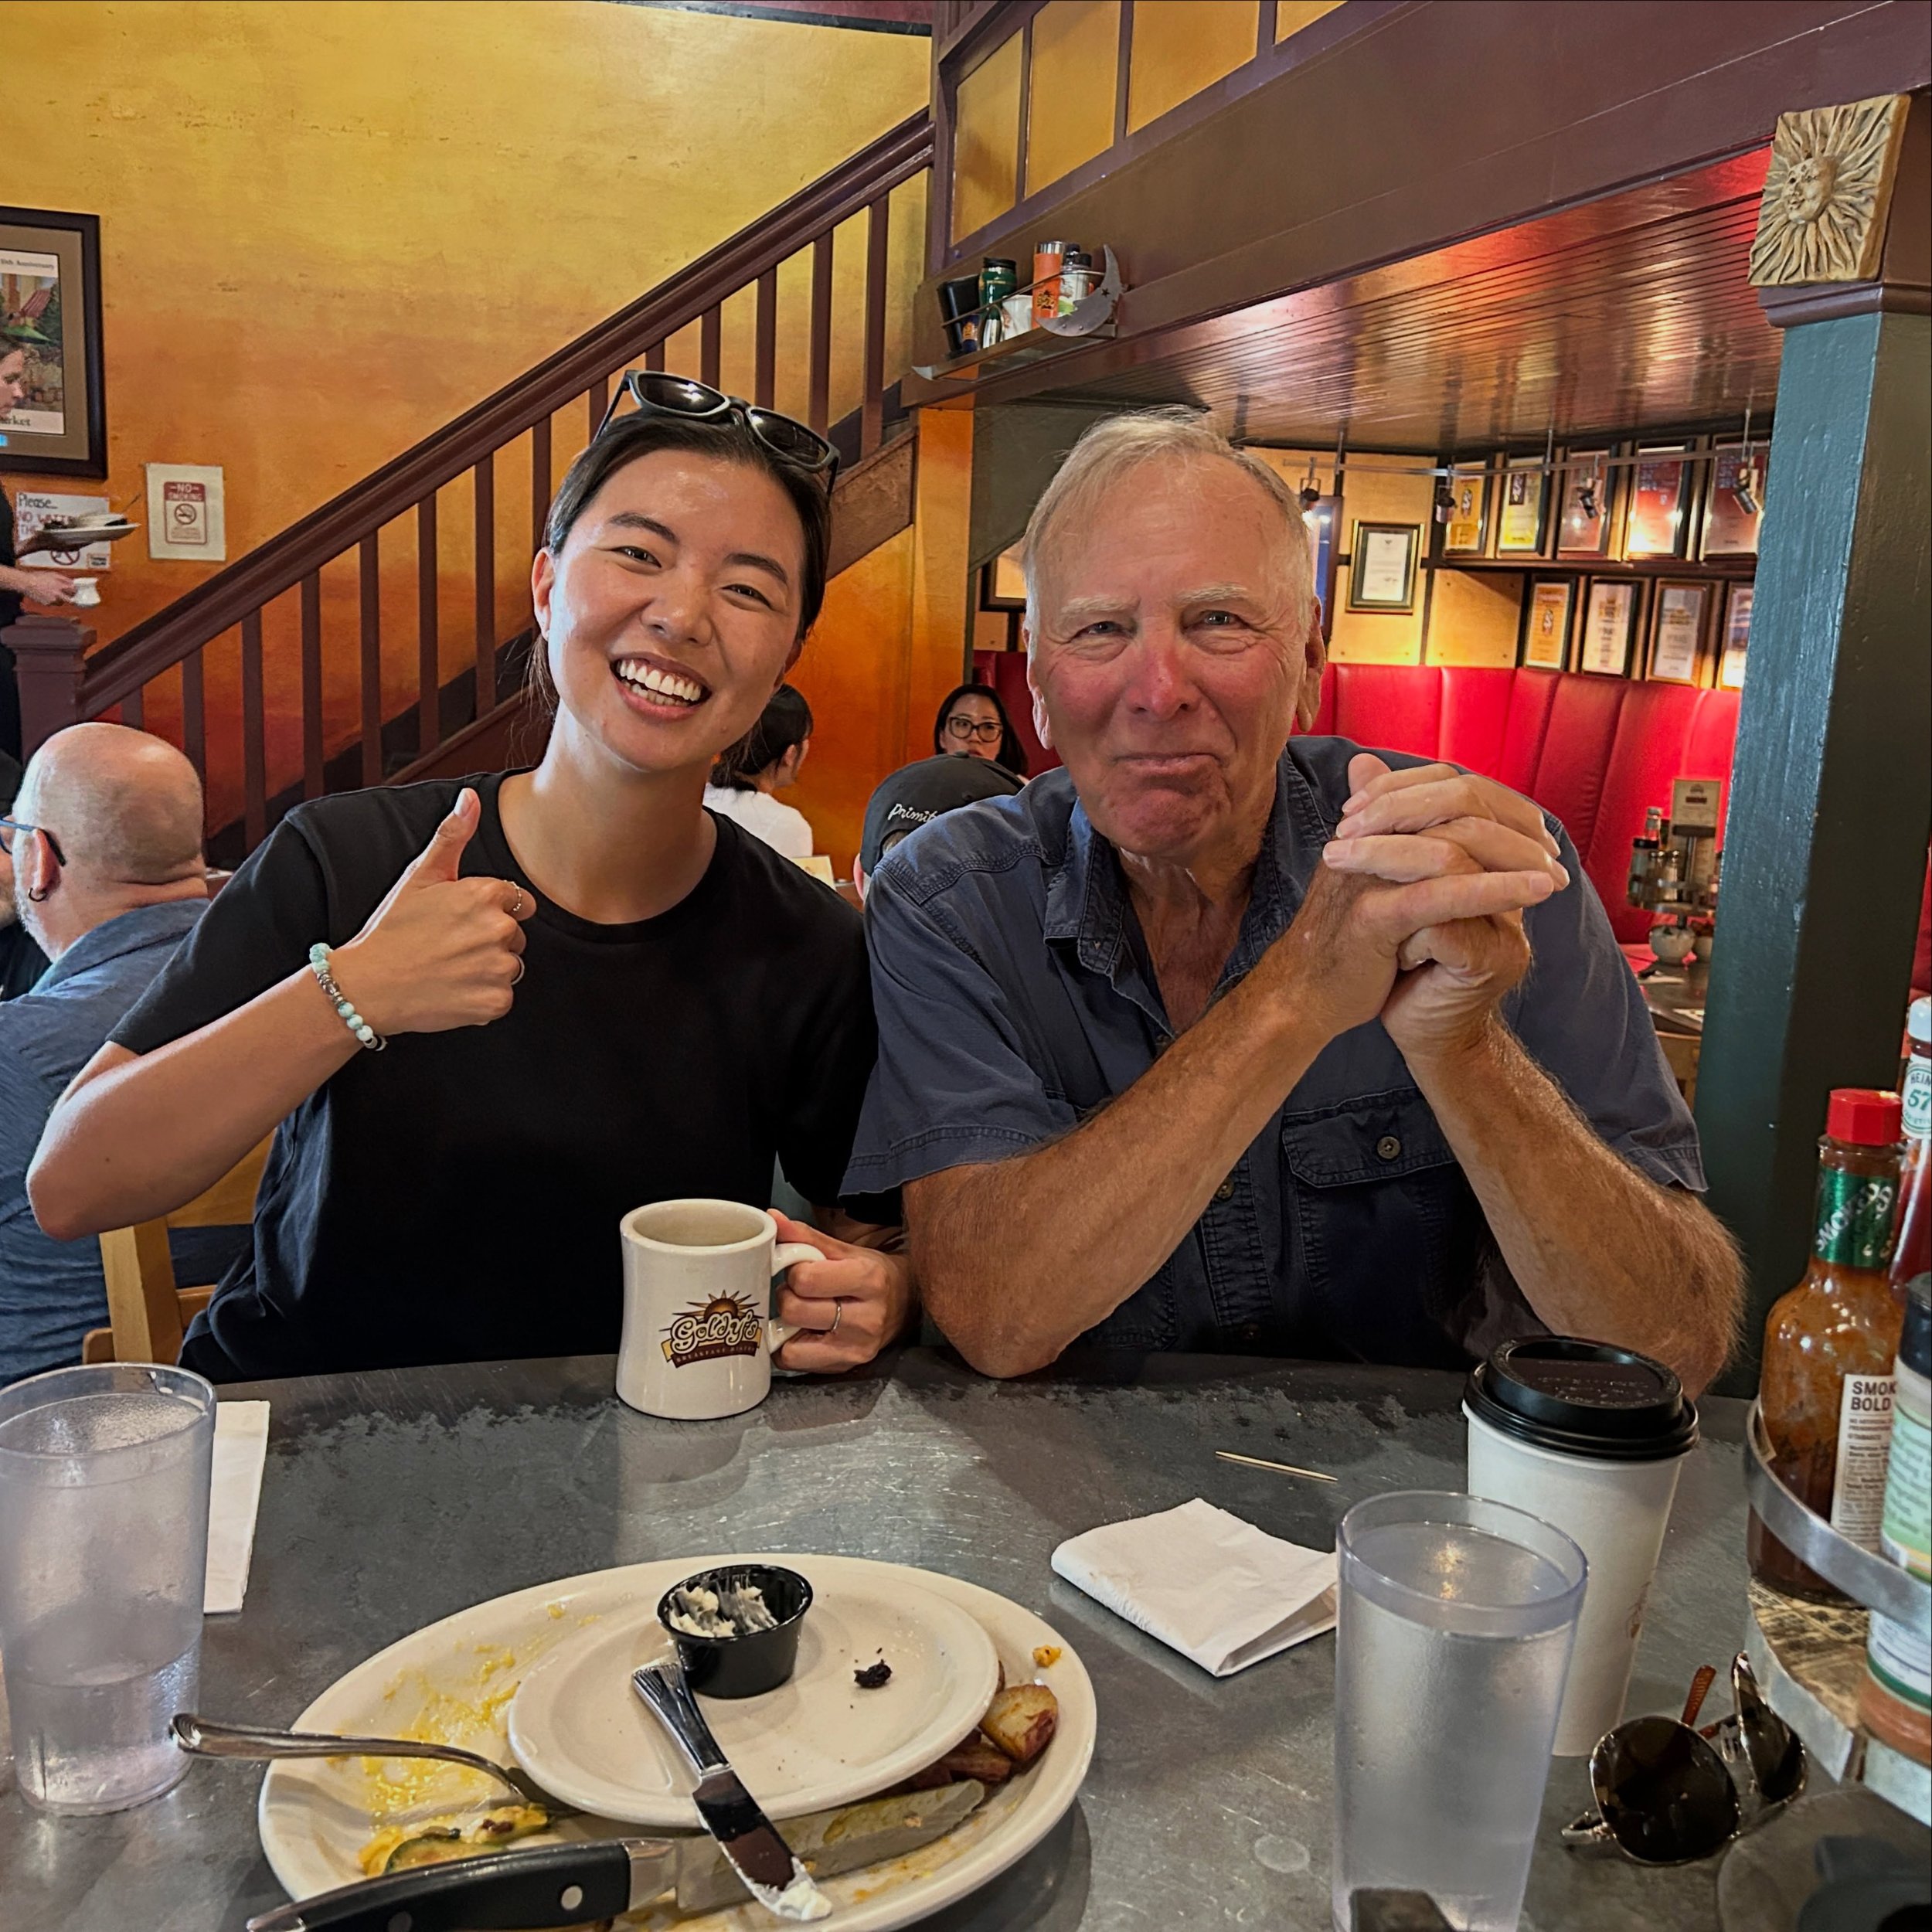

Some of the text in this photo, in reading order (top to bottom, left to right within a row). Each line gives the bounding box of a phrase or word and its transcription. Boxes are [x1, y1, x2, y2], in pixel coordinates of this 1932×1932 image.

[177, 483, 192, 494] NO
[887, 803, 939, 822] Primit
[1907, 1089, 1931, 1111] 57
[671, 1309, 759, 1354] Goldy's
[1850, 1396, 1893, 1412] BOLD
